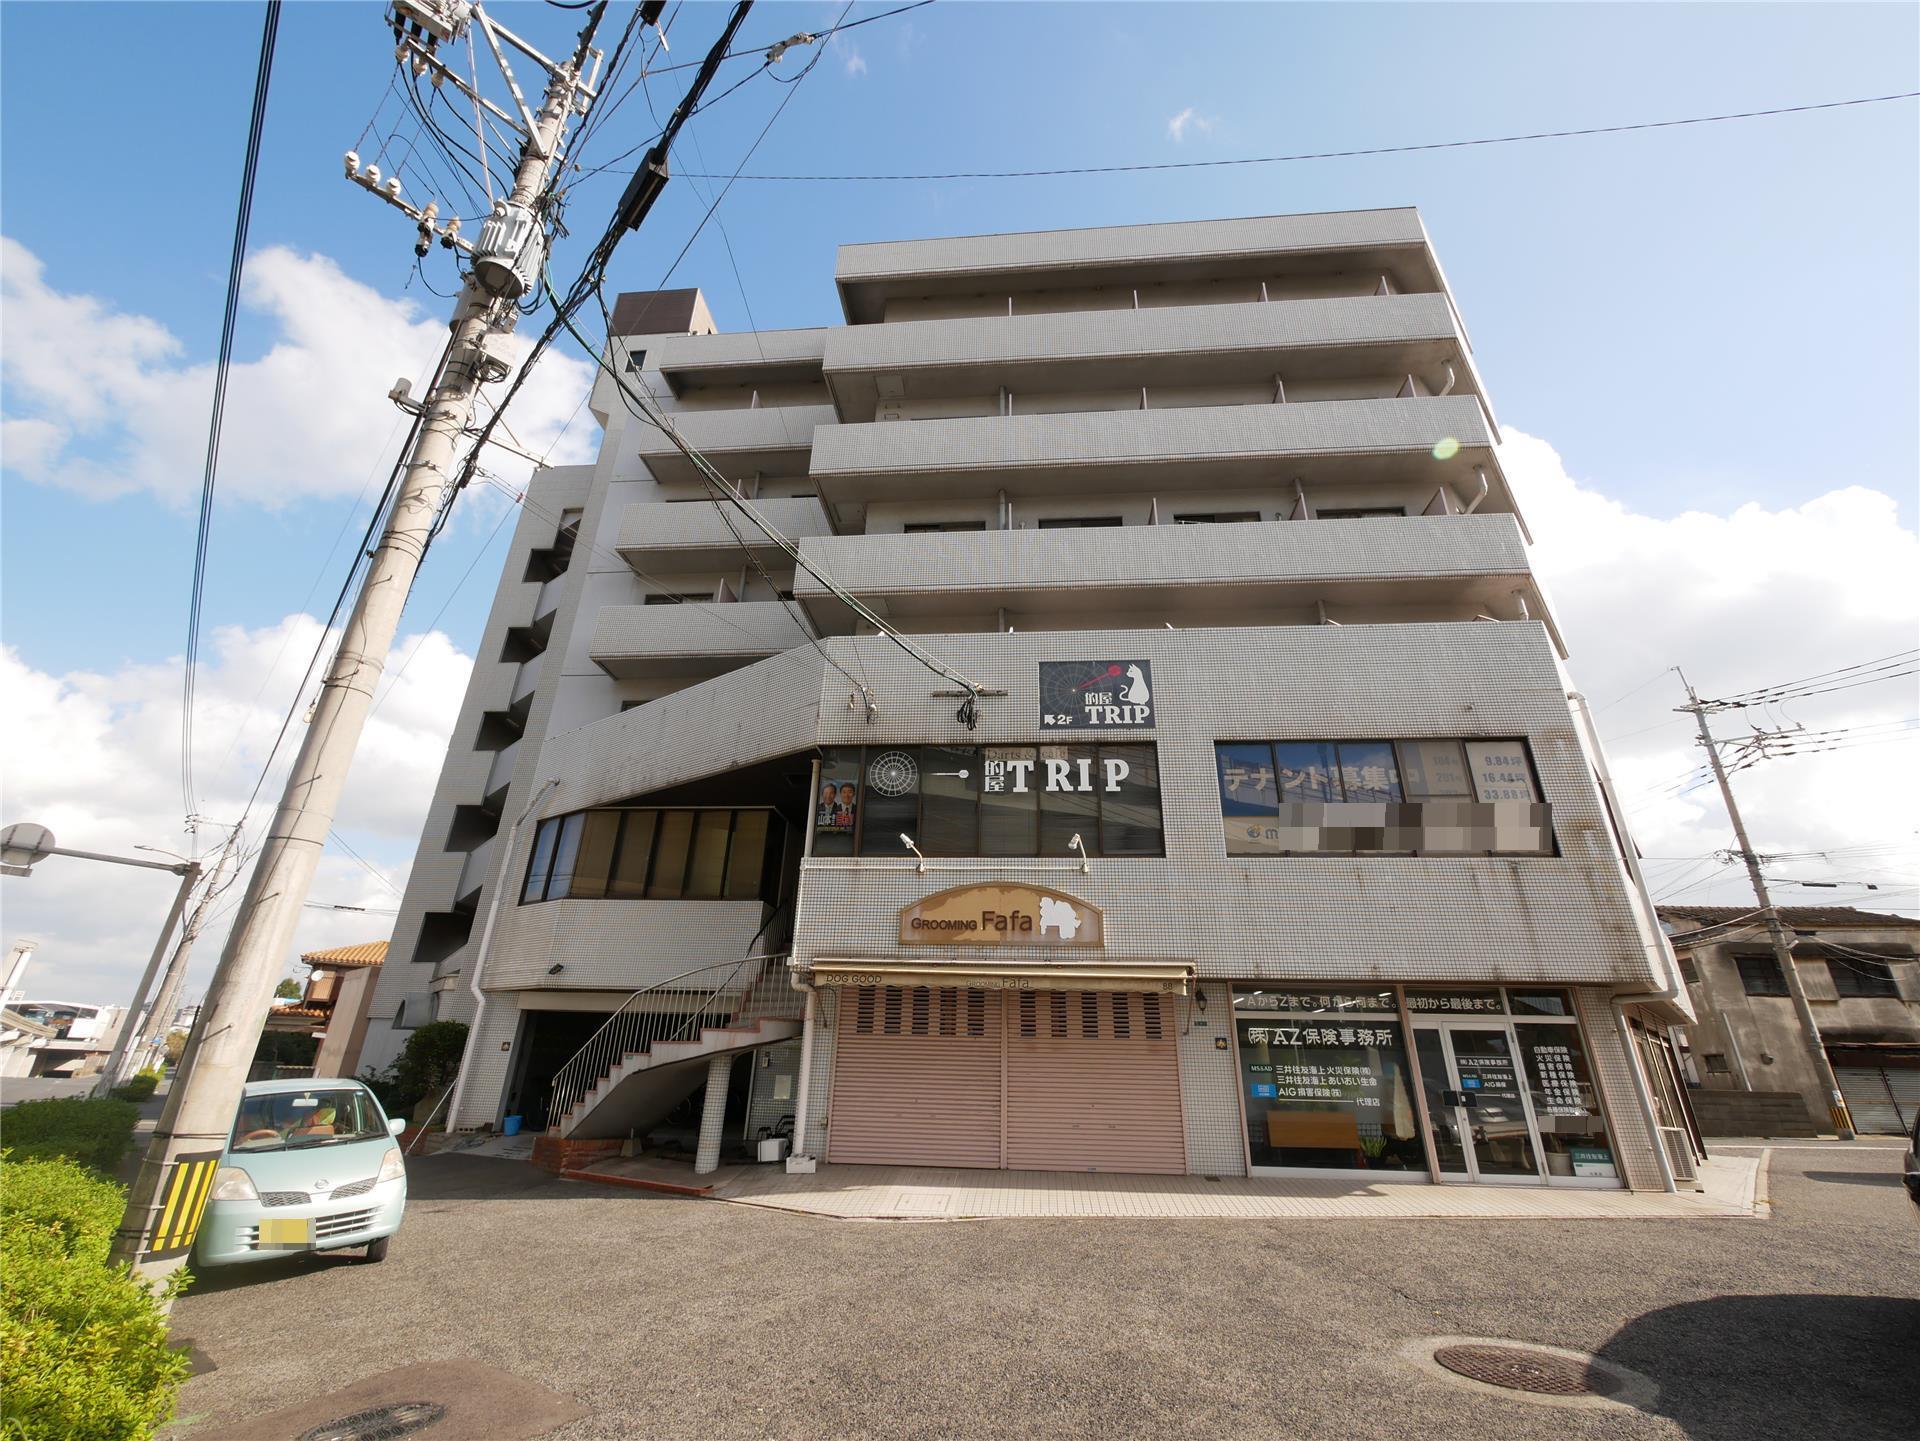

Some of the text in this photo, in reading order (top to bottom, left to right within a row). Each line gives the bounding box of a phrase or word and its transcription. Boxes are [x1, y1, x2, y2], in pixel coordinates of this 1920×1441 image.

[1057, 714, 1073, 725] 2F
[1084, 705, 1151, 724] TRIP
[987, 749, 1022, 760] Darts
[984, 760, 1005, 792] 的屋
[1006, 758, 1130, 793] TRIP
[911, 910, 1033, 931] GROOMING Fafa
[826, 974, 882, 984] DOG GOOD
